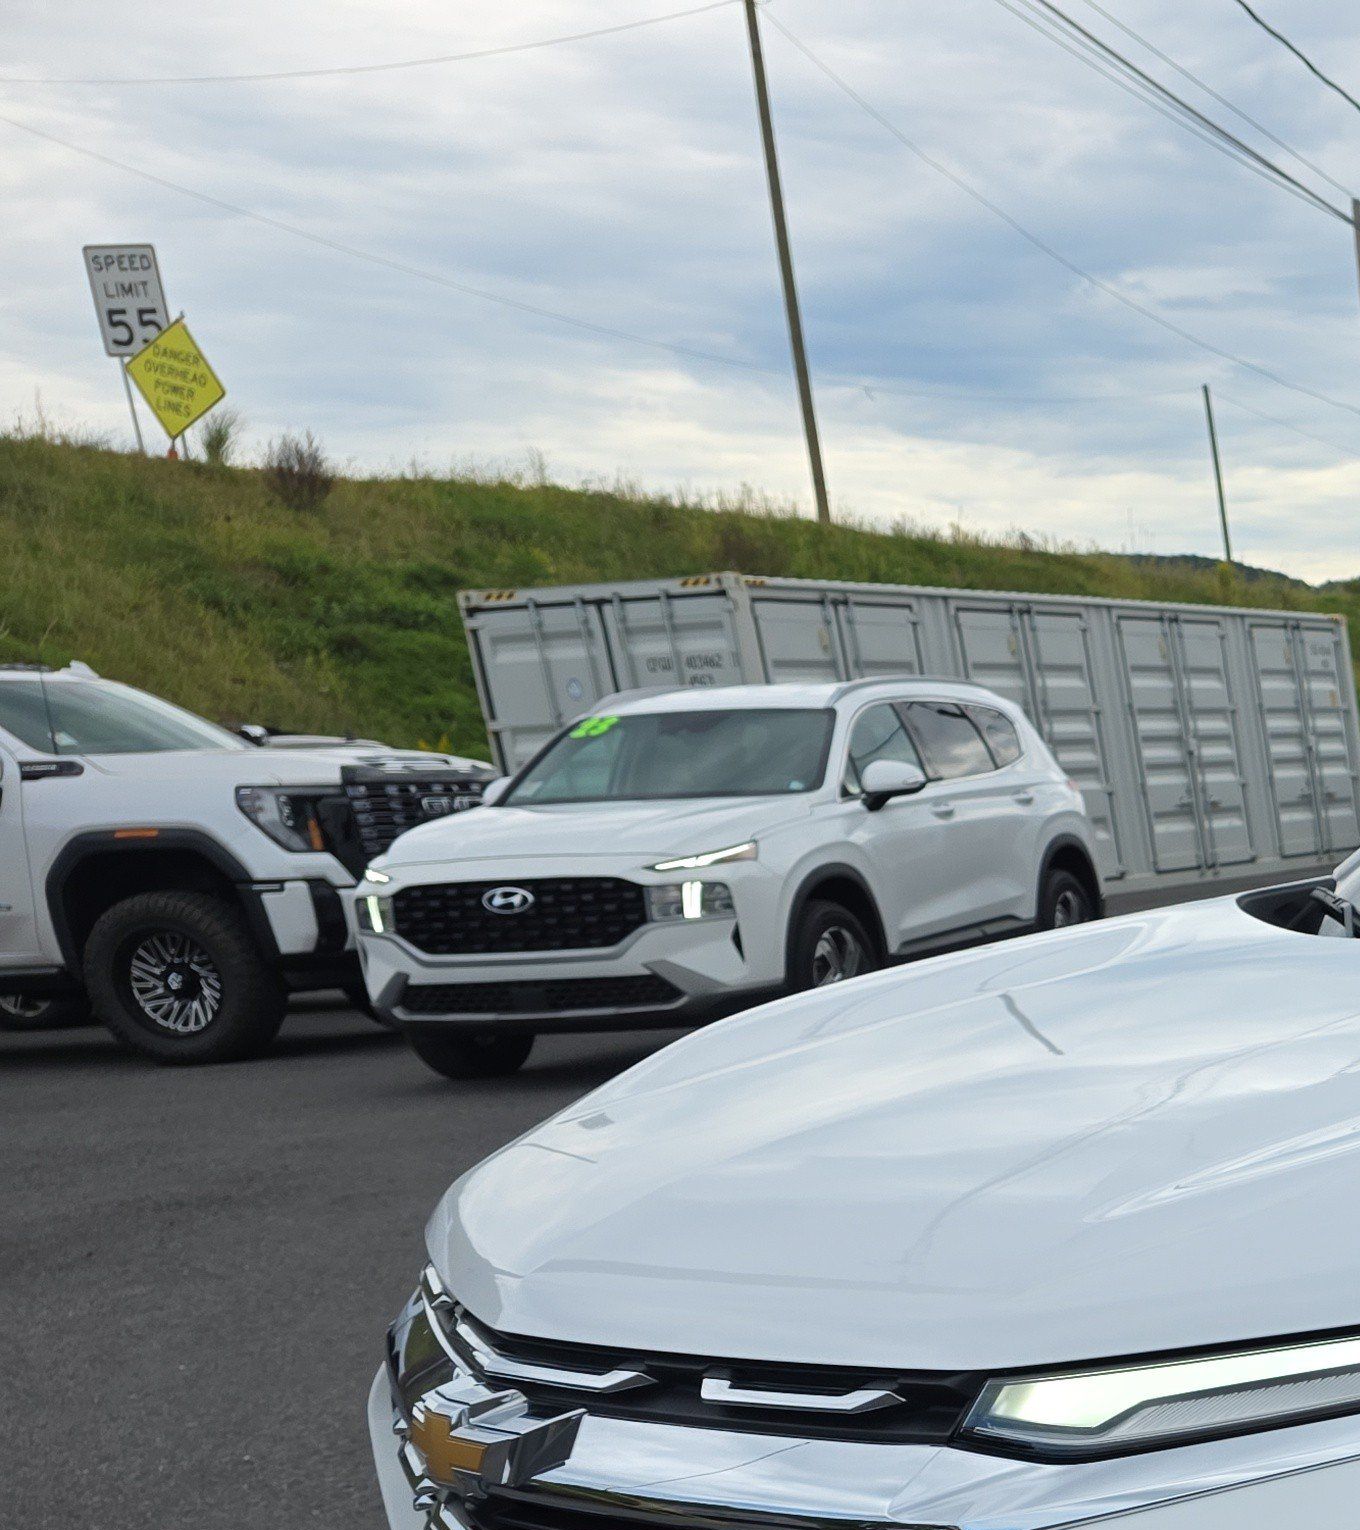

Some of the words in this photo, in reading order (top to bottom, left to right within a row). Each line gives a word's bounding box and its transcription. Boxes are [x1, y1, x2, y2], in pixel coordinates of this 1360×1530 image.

[91, 254, 151, 273] SPEED
[103, 281, 149, 298] LIMIT
[107, 308, 163, 346] 55
[153, 344, 201, 367] DANGER
[144, 359, 207, 387] OVERHEAD
[154, 380, 195, 399] POWER
[156, 399, 191, 417] LINES
